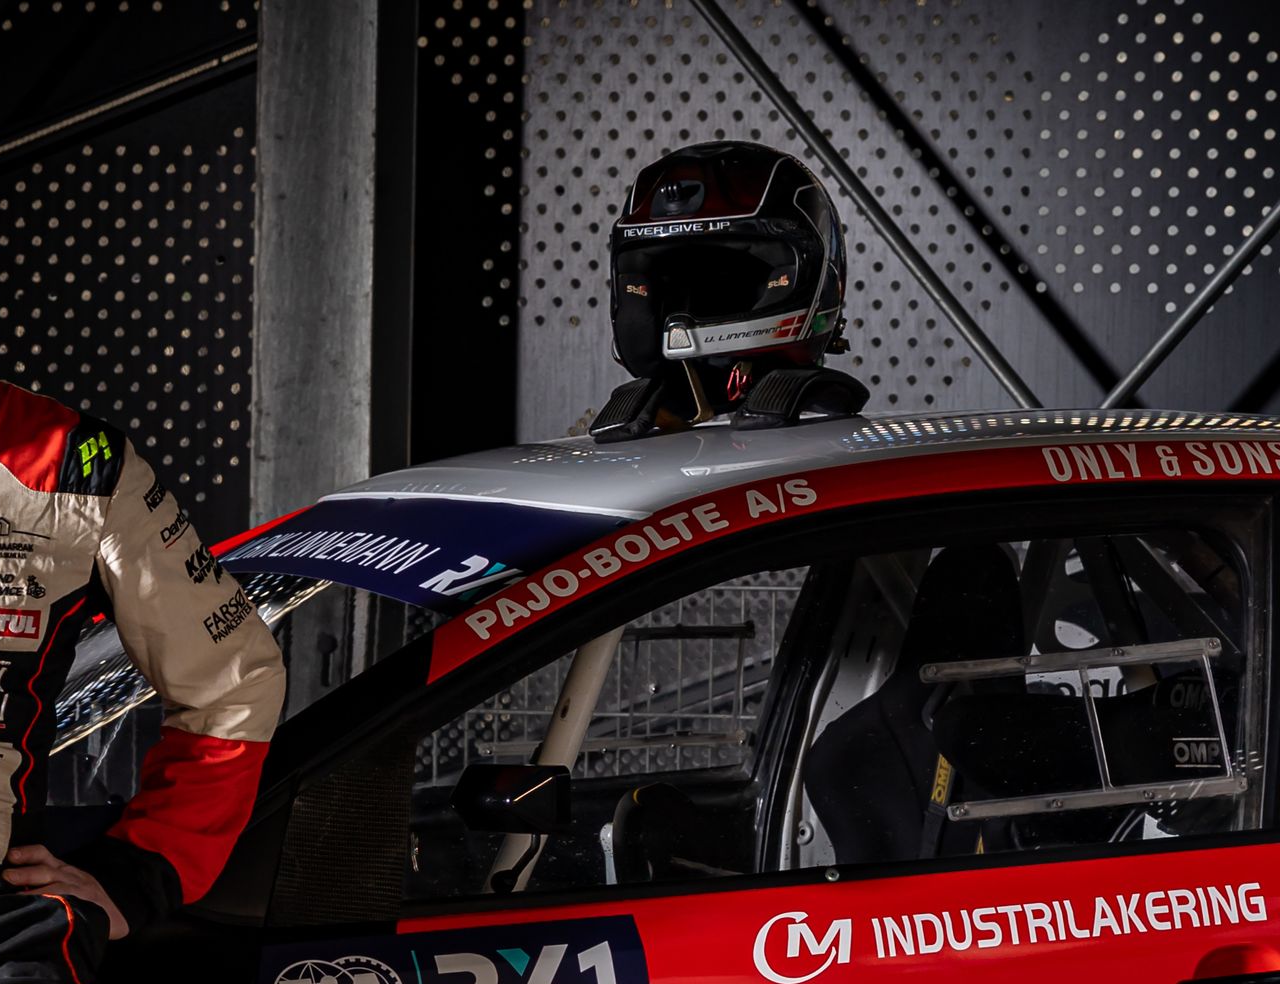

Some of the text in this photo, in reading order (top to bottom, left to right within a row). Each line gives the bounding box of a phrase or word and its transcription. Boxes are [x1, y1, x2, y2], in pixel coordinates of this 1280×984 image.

[624, 221, 731, 238] NEVER GIVE UP
[1042, 446, 1143, 482] ONLY
[1159, 445, 1183, 477] &
[464, 478, 818, 640] PAJO-BOLTE A/S
[871, 883, 1266, 959] INDUSTRILAKERING
